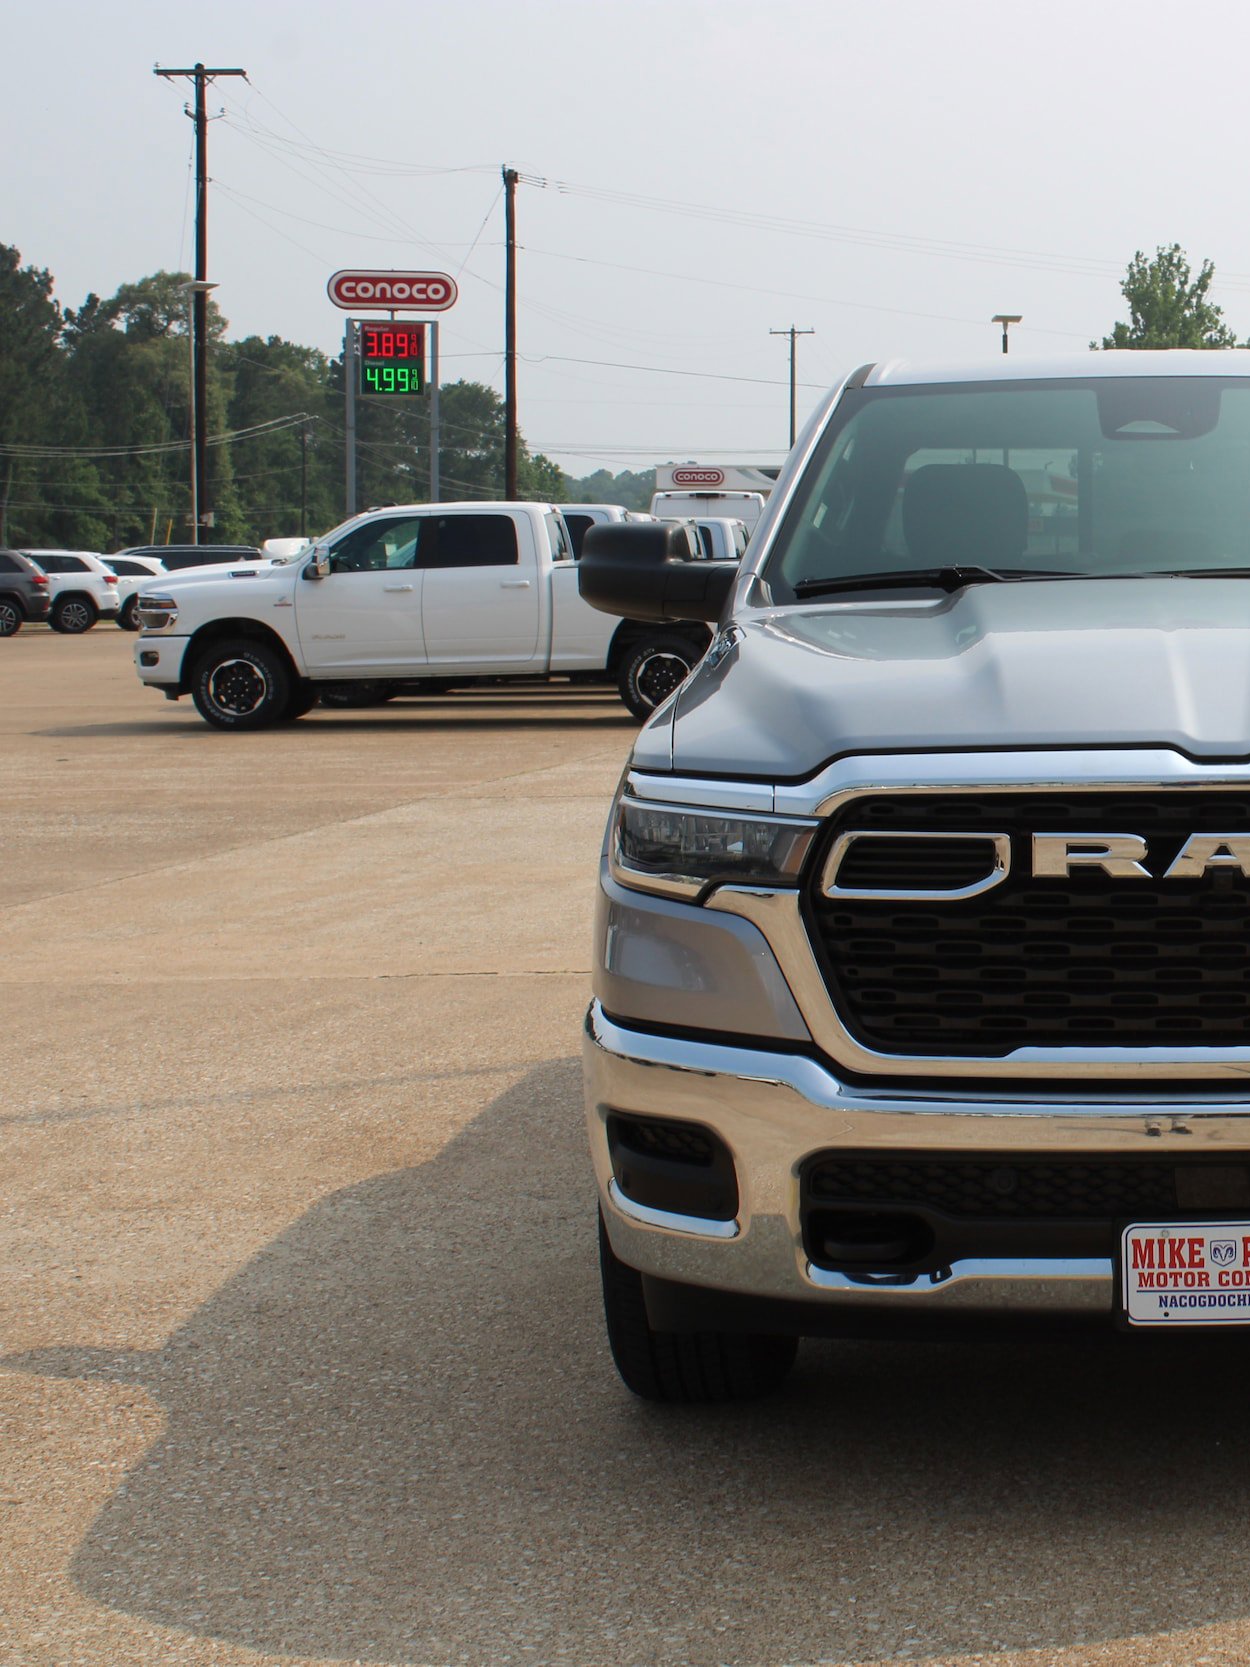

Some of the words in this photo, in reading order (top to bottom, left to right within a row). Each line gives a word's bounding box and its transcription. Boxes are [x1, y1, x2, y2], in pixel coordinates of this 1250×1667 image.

[366, 332, 408, 357] 3.89
[366, 368, 409, 392] 4.99
[1131, 1238, 1206, 1270] MIKE
[1137, 1271, 1210, 1288] MOTOR
